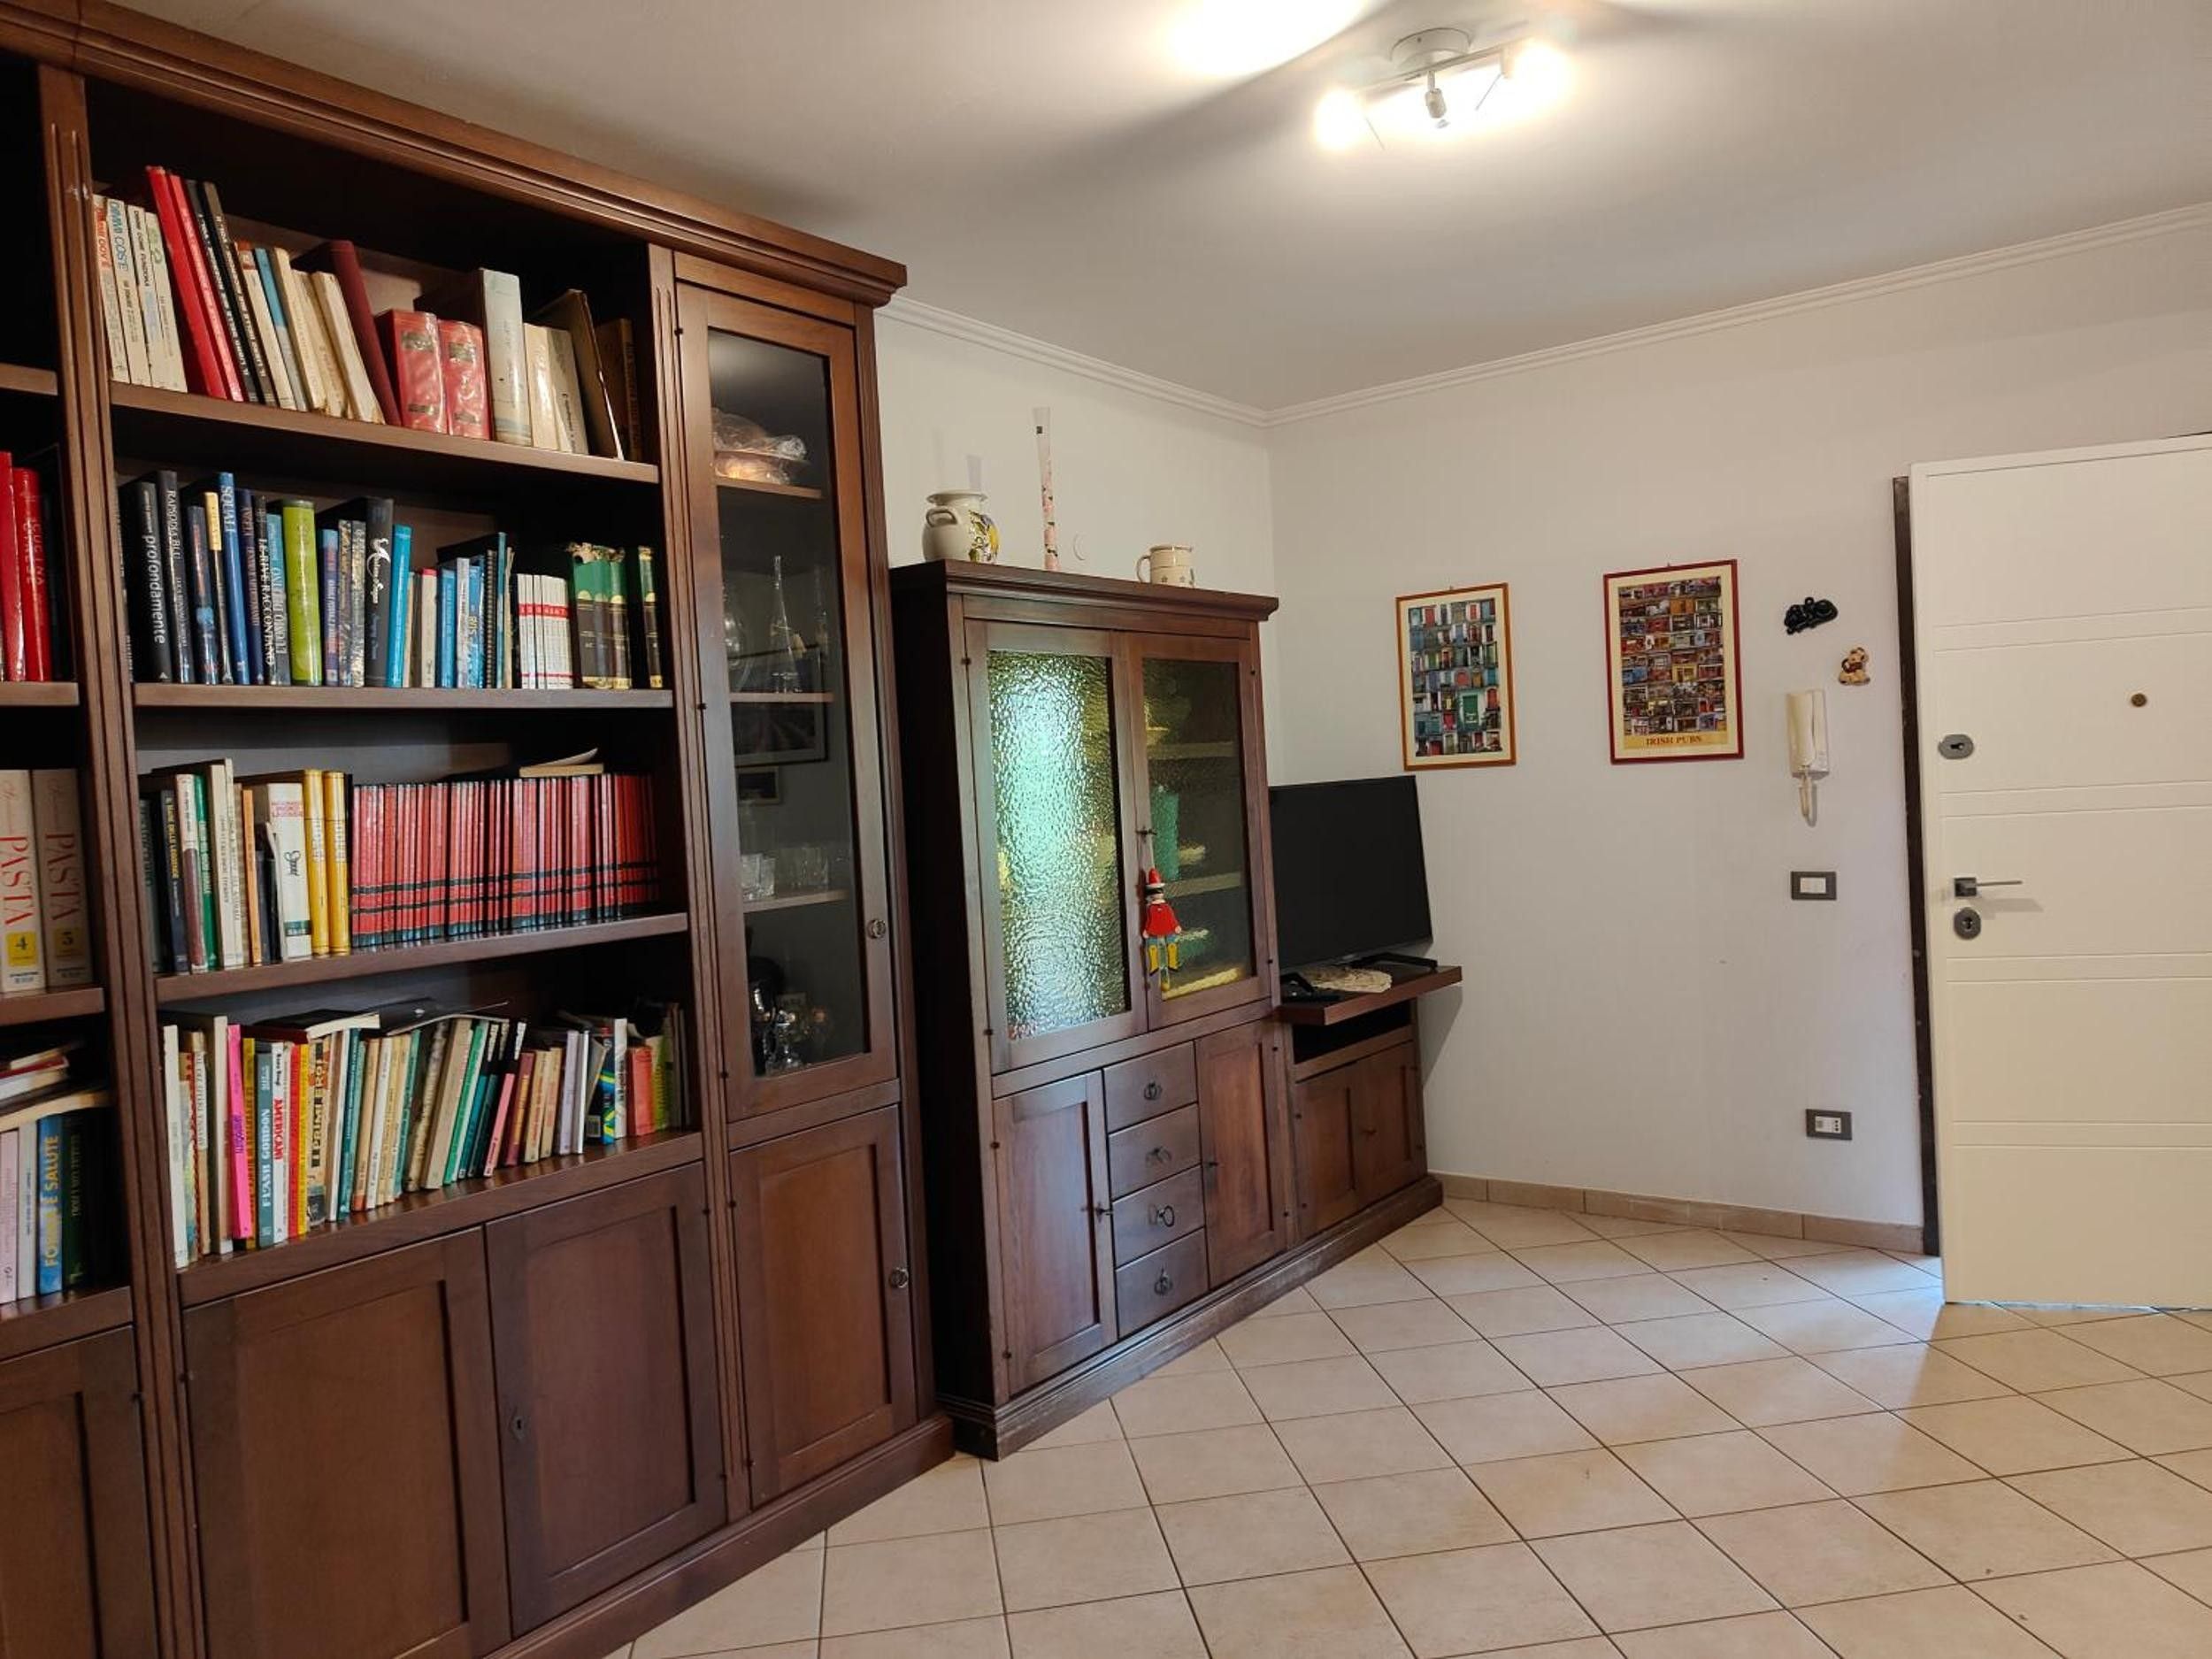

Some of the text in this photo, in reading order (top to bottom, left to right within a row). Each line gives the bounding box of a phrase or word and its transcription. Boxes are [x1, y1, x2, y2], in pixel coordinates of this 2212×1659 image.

[110, 202, 124, 234] DIMMI
[220, 485, 236, 533] SQUALI
[142, 535, 167, 644] profondamente
[261, 585, 274, 666] RACCONTANO
[1646, 735, 1702, 746] IRISH PUBS
[0, 836, 35, 926] PASTA
[44, 833, 81, 921] PASTA
[15, 936, 28, 950] 4
[61, 931, 73, 946] 5
[44, 1135, 58, 1191] SALUTE
[260, 1108, 271, 1208] FLASH GORDON
